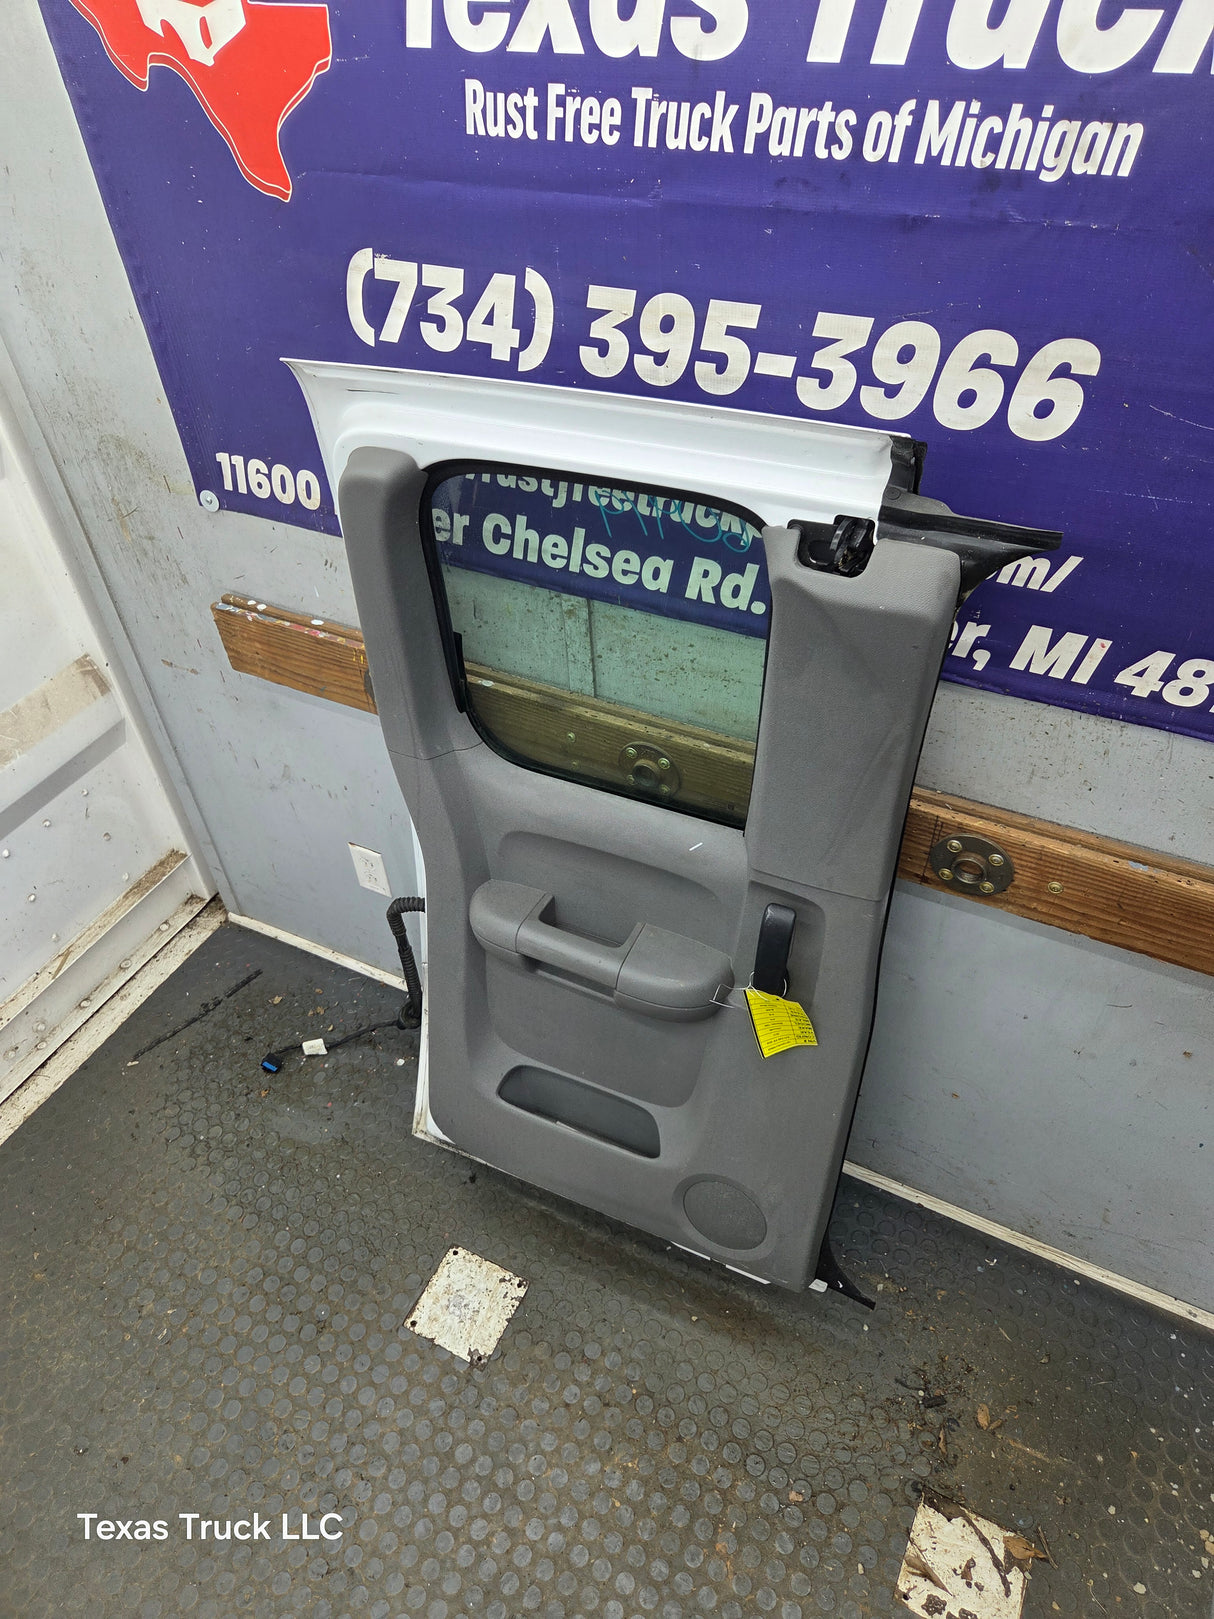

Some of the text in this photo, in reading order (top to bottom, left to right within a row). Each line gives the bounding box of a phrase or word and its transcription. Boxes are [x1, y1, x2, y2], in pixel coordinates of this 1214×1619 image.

[465, 78, 1144, 182] Rust Free Truck Parts of Michigan
[346, 247, 1101, 441] (734) 395-3966
[216, 452, 321, 511] 11600
[482, 512, 674, 593] Chelsea
[685, 556, 767, 615] Rd.
[1009, 624, 1113, 685] MI
[1114, 650, 1214, 713] 48
